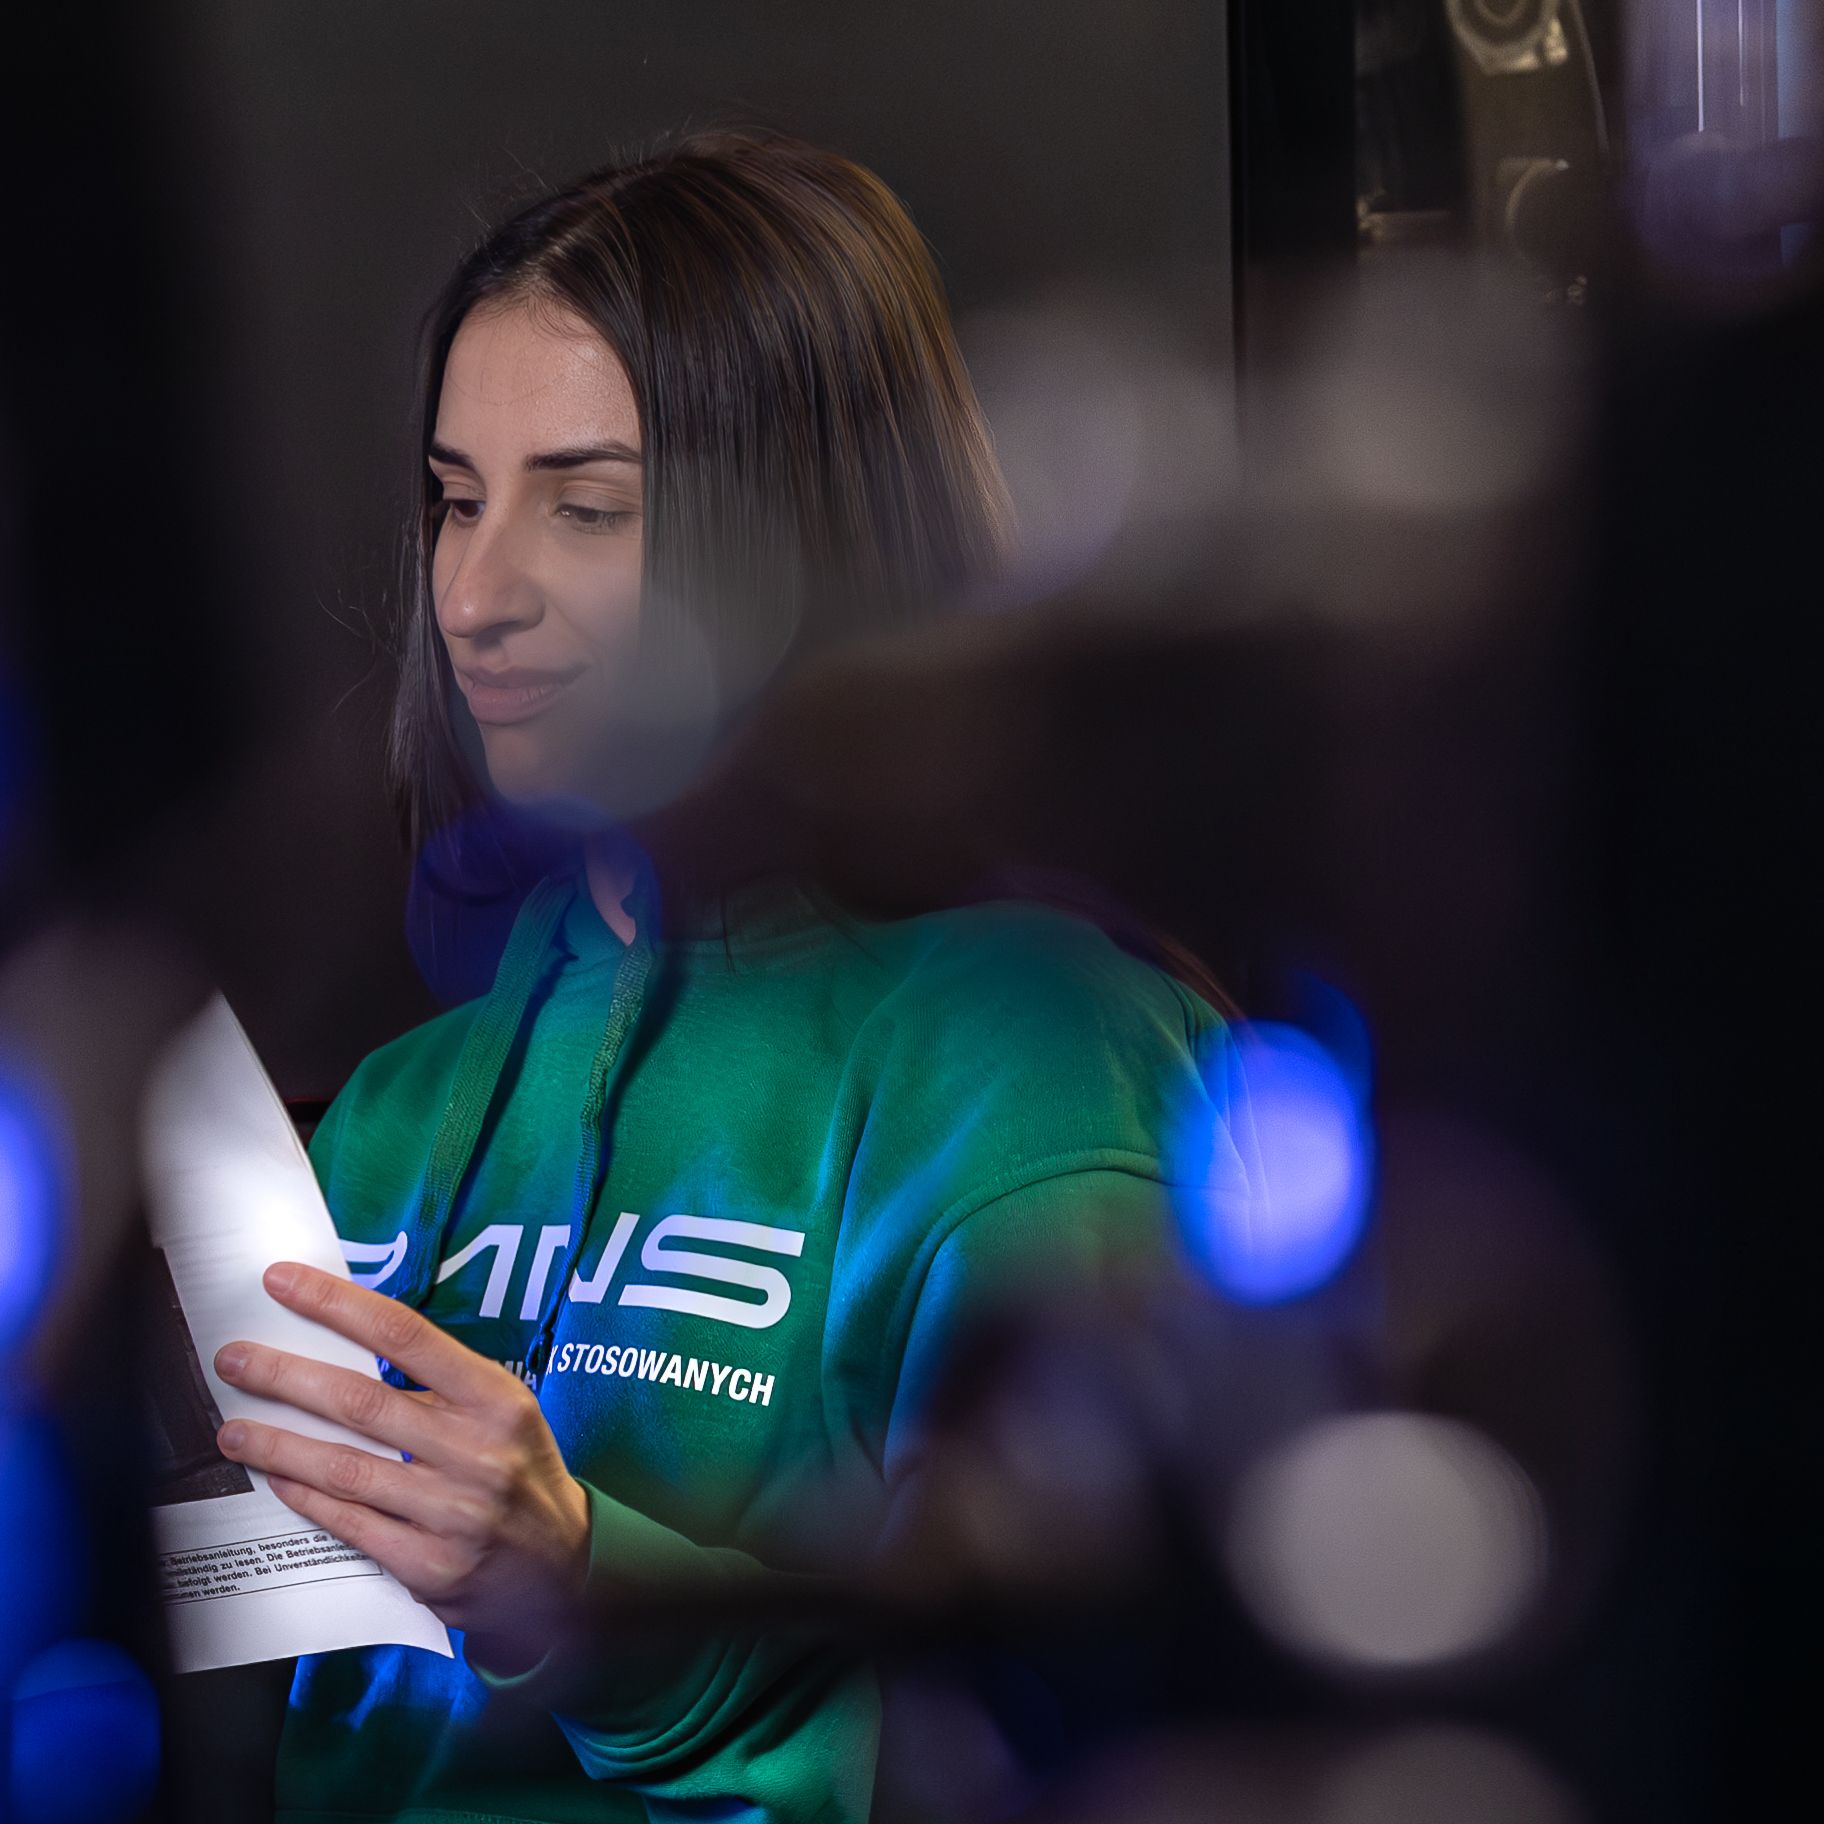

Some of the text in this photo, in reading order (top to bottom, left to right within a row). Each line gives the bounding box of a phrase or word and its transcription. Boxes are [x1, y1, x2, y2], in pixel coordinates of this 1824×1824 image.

[557, 1342, 776, 1407] STOSOWANYCH
[258, 1536, 310, 1551] besonders
[313, 1533, 328, 1543] die
[221, 1562, 233, 1571] zu
[235, 1556, 265, 1568] lesen.
[266, 1551, 283, 1562] Die
[213, 1571, 253, 1582] werden.
[255, 1565, 272, 1576] Bei
[201, 1584, 241, 1597] werden.
